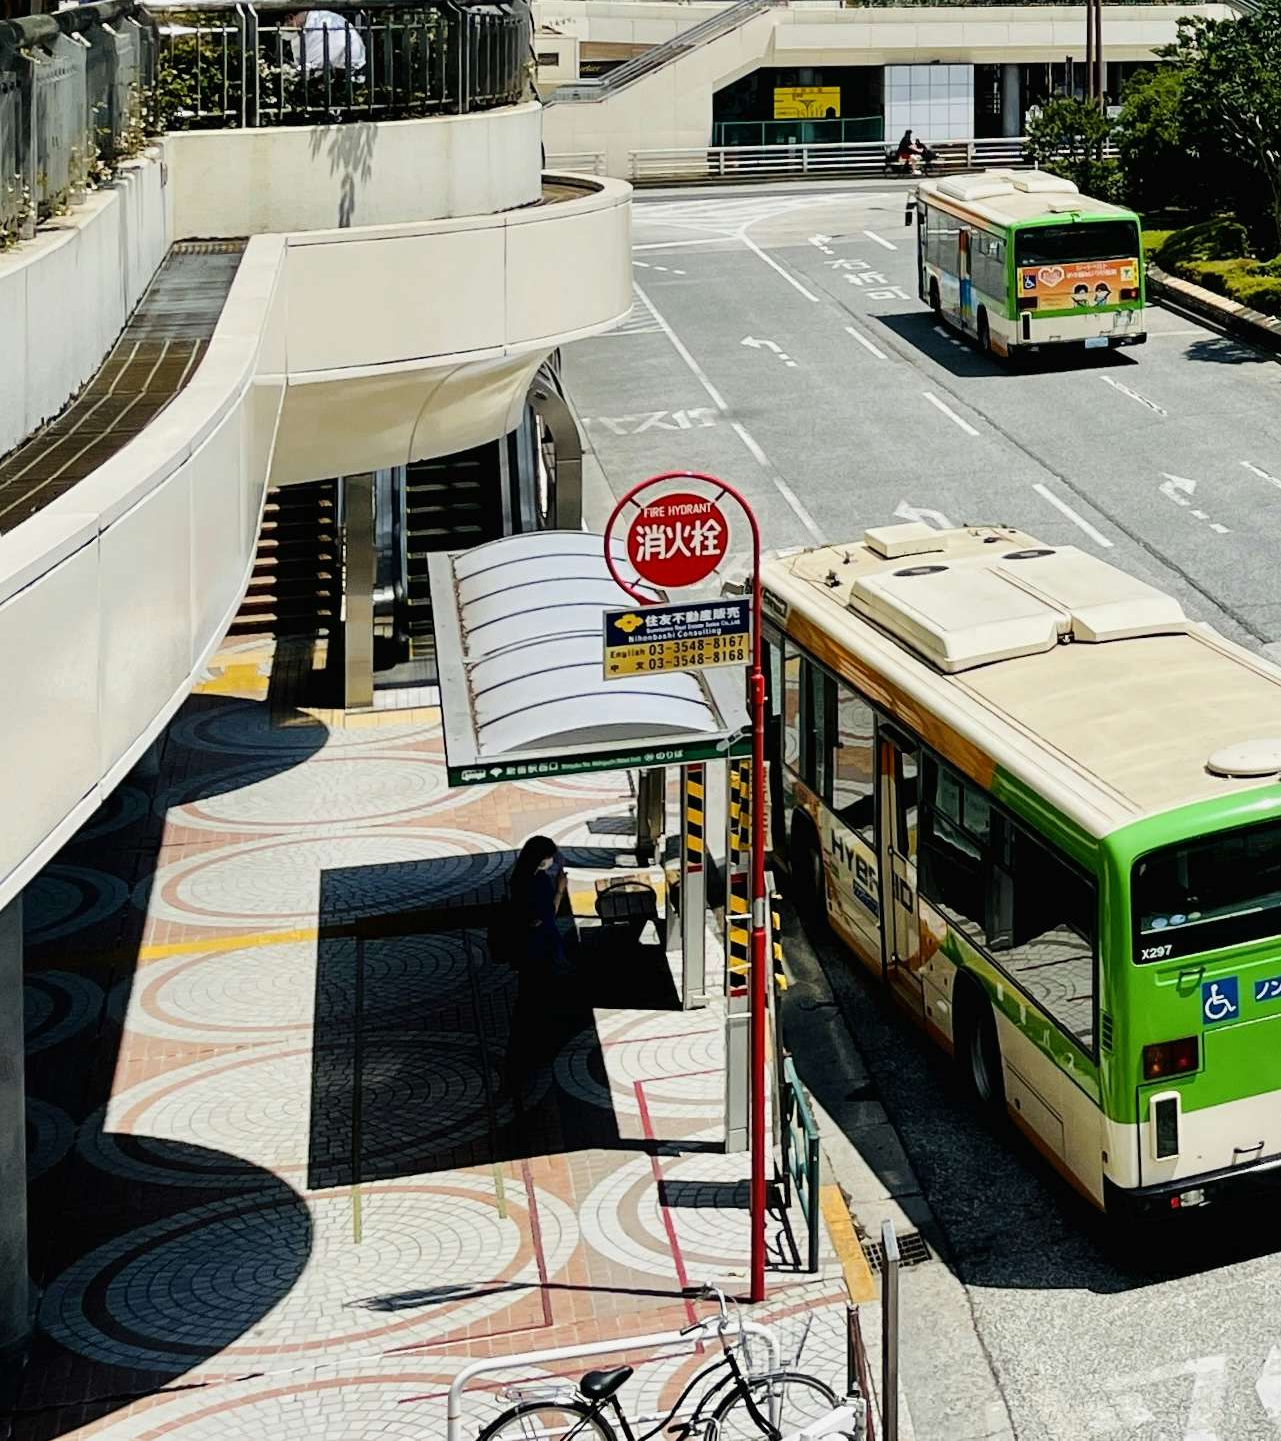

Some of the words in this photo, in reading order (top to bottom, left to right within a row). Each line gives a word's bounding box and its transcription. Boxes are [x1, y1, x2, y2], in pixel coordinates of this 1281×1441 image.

[643, 506, 665, 518] FIRE
[667, 502, 712, 517] HYDRANT
[635, 518, 722, 562] 消火栓
[645, 606, 741, 627] 住友不動産販売
[610, 648, 646, 659] English
[648, 635, 744, 656] 03-3548-8167
[628, 630, 676, 643] Nihonbashi
[648, 648, 744, 670] 03-3548-8168
[1140, 943, 1173, 961] X297
